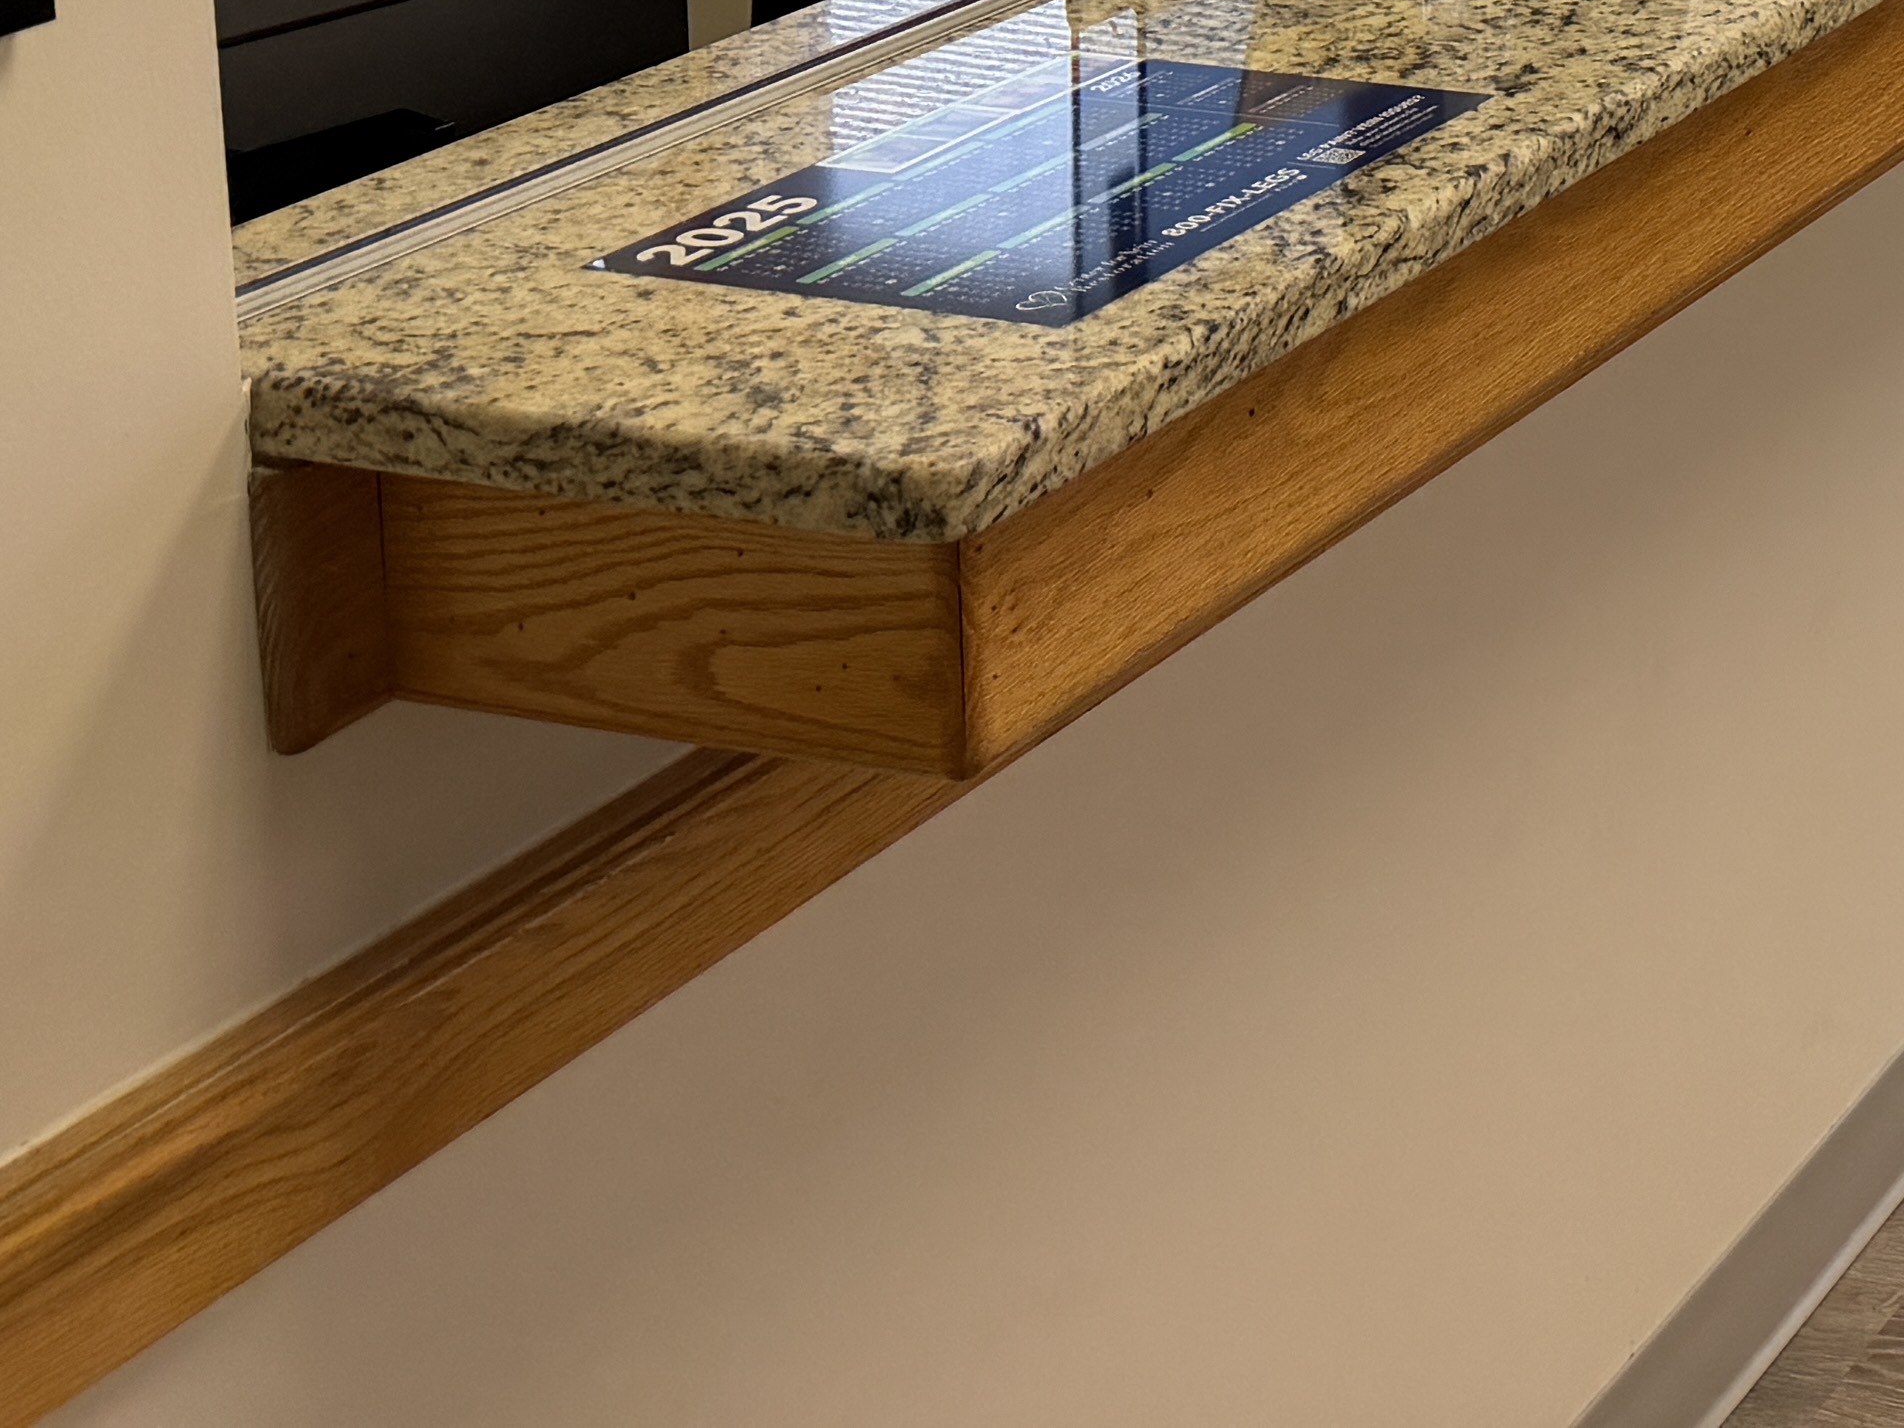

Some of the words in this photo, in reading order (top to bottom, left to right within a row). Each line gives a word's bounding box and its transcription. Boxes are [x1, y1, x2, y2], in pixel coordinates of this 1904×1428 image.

[1090, 72, 1141, 92] 2026
[637, 195, 817, 267] 2025
[1161, 167, 1301, 238] 800-FIX-LEGS
